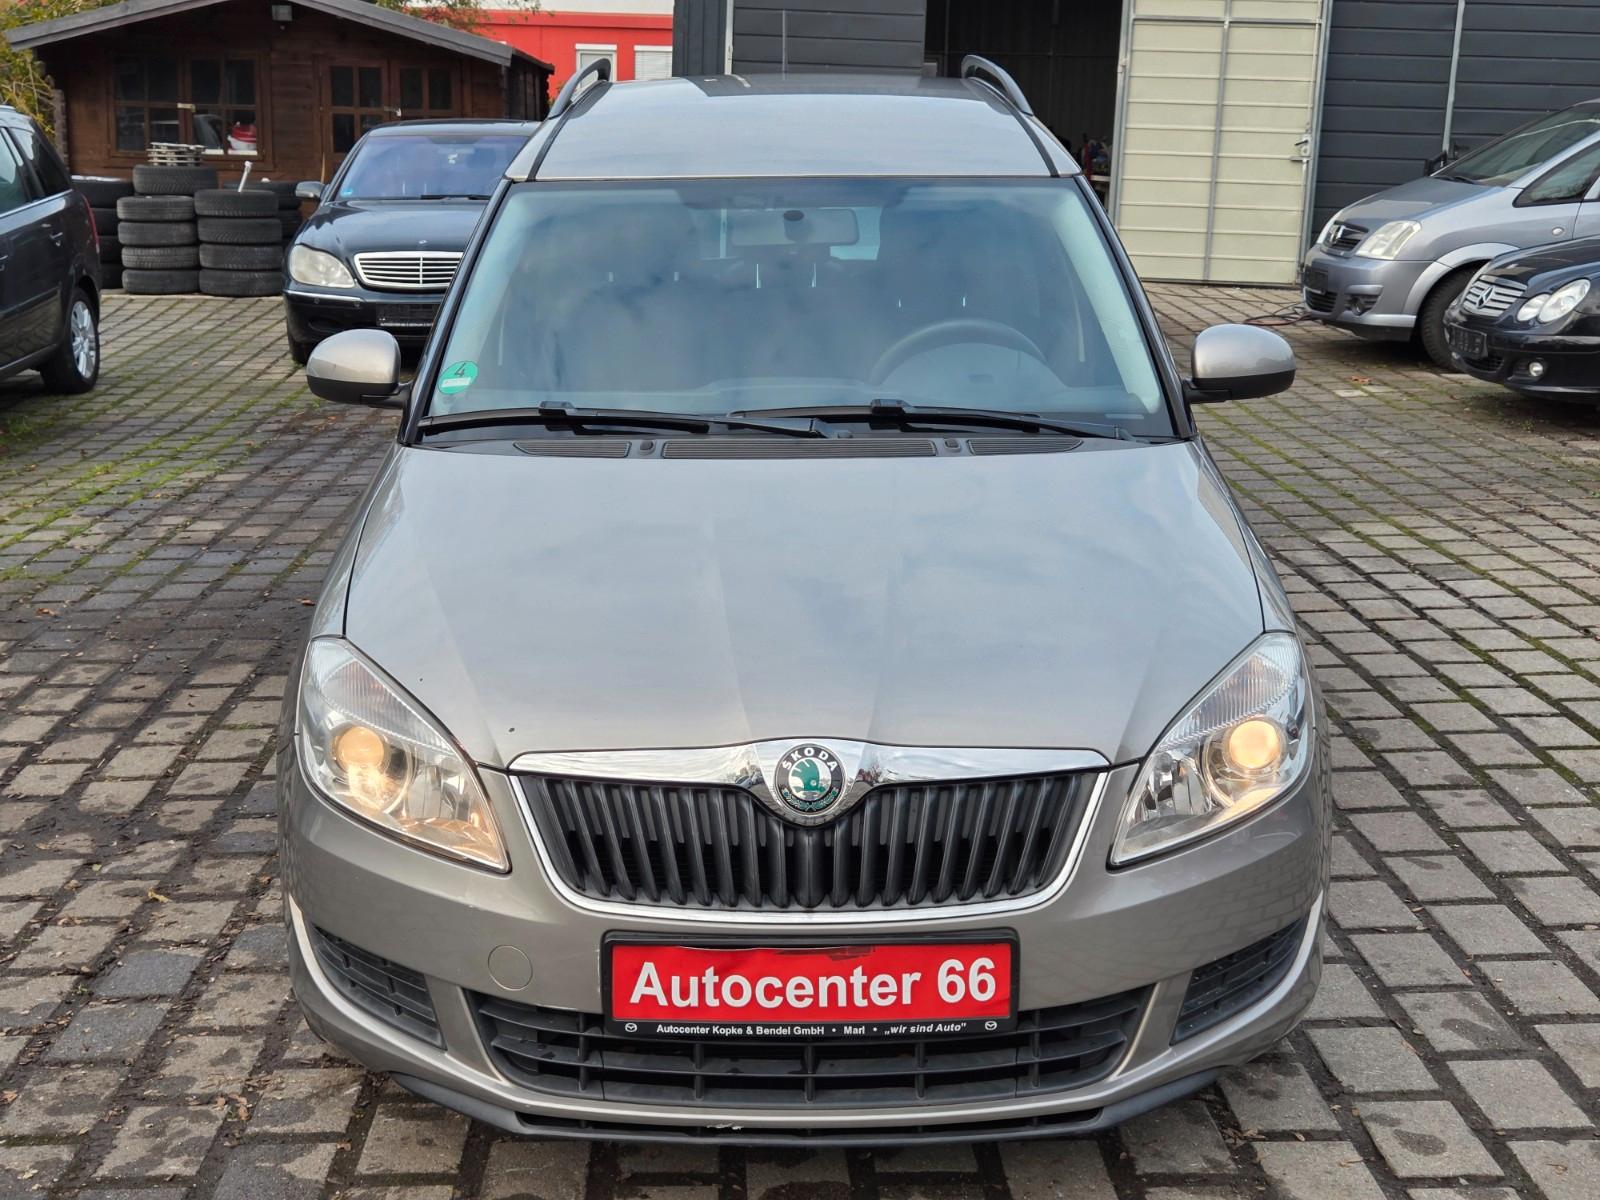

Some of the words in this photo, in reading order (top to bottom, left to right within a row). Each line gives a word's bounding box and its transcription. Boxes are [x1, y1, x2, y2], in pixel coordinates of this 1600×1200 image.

[454, 362, 466, 377] 4
[782, 747, 838, 772] SKODA
[629, 961, 922, 1009] Autocenter
[937, 957, 996, 1004] 66
[656, 1024, 710, 1034] Autocenter
[712, 1025, 743, 1036] Kopke
[745, 1026, 753, 1035] &
[756, 1026, 791, 1035] Bendel
[793, 1026, 825, 1035] GmbH
[843, 1026, 866, 1035] Marl
[909, 1023, 934, 1033] sind
